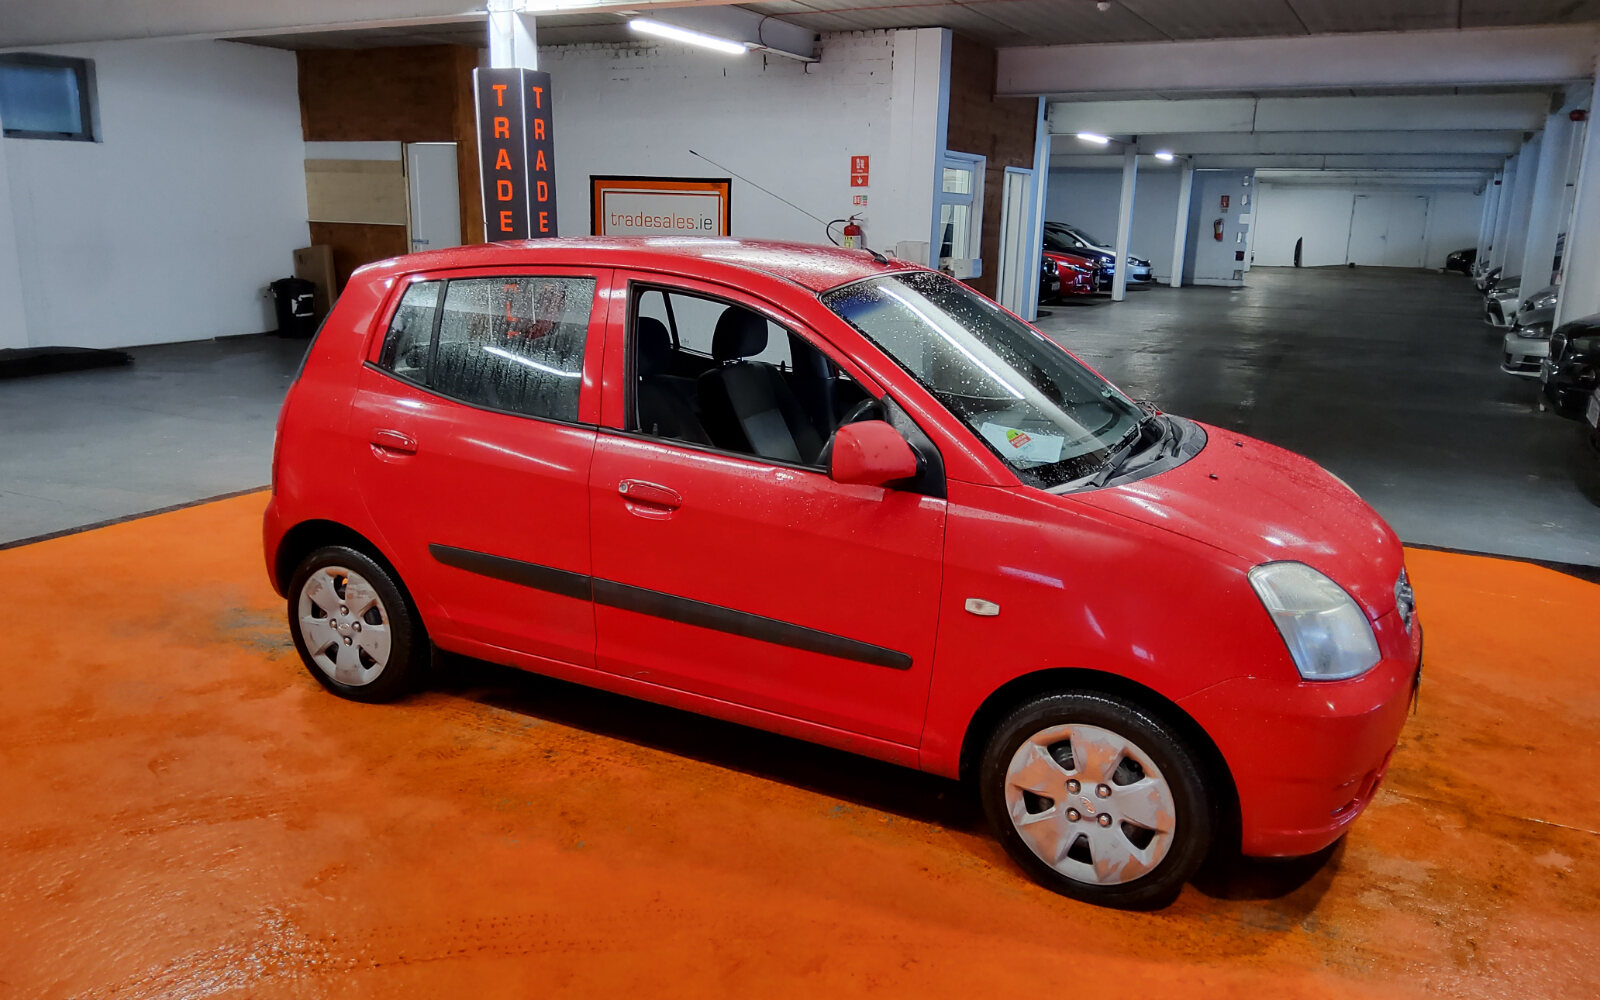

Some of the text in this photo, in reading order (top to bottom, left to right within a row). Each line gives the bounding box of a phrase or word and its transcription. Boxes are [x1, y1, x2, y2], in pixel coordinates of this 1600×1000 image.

[492, 84, 514, 232] TRADE
[533, 86, 549, 232] TRADE
[611, 211, 713, 231] tradesales.ie
